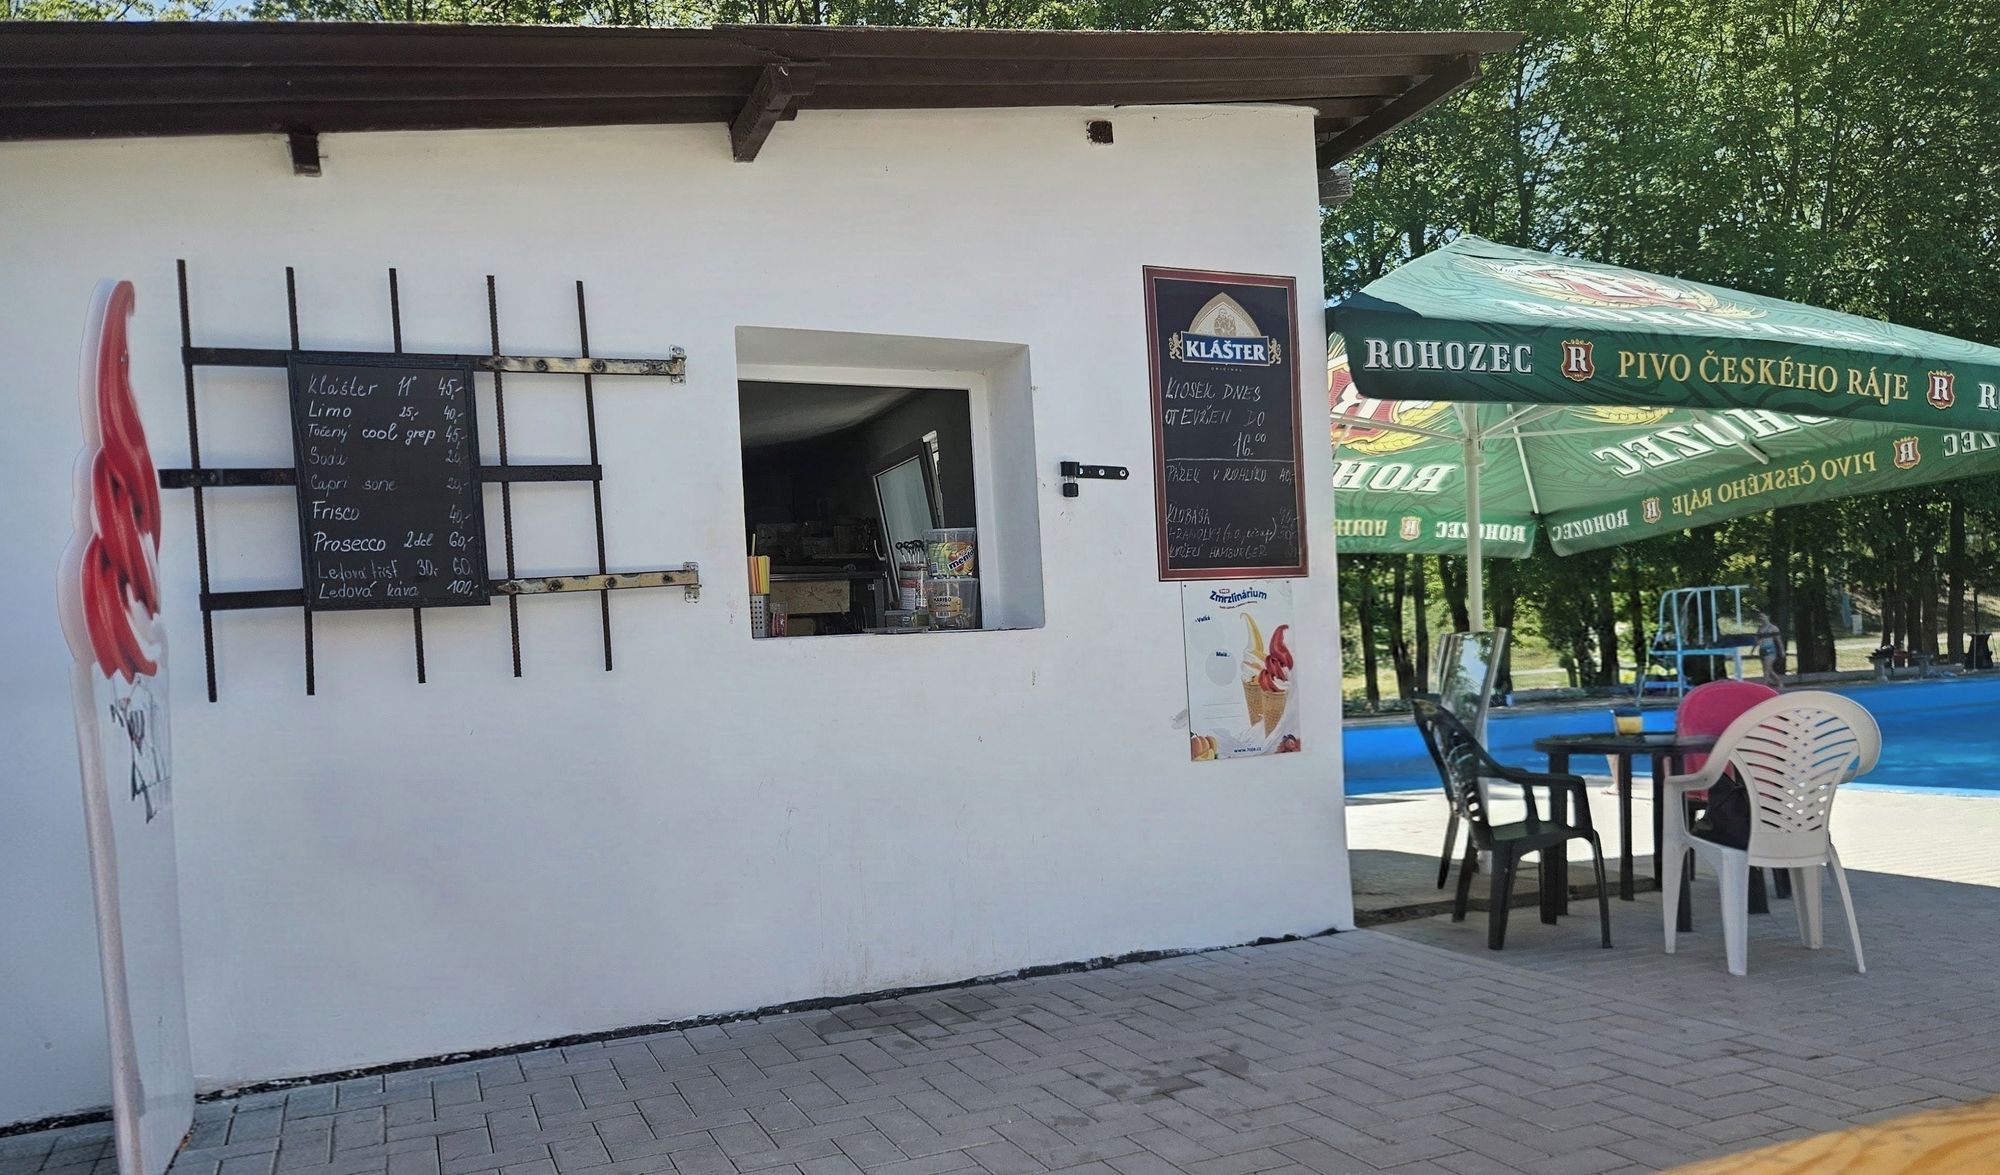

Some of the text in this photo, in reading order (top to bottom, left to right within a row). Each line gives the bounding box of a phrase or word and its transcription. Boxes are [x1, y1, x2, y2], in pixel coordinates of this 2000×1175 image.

[1186, 339, 1266, 361] KLÁŠTER
[1364, 339, 1533, 373] ROHOZEC
[1568, 346, 1588, 372] R
[438, 377, 464, 400] 45,-
[1618, 350, 1909, 405] PIVO ČESKÉHO RÁJE
[1932, 376, 1949, 401] R
[1166, 377, 1261, 402] KIOSEK DNES
[308, 400, 464, 424] Limo 25,- 40,-
[1165, 404, 1265, 427] OTEVŘEN DO
[308, 423, 351, 443] Točený
[362, 422, 398, 440] cool
[405, 428, 436, 446] grep
[311, 474, 348, 497] Capri
[362, 479, 398, 492] sone
[1213, 469, 1220, 481] V
[312, 501, 359, 521] Frisco
[313, 531, 474, 553] Prosecco 2dcl 60,-
[319, 580, 478, 600] Ledová káva 100,-
[1210, 587, 1268, 603] Zmrzlinárium
